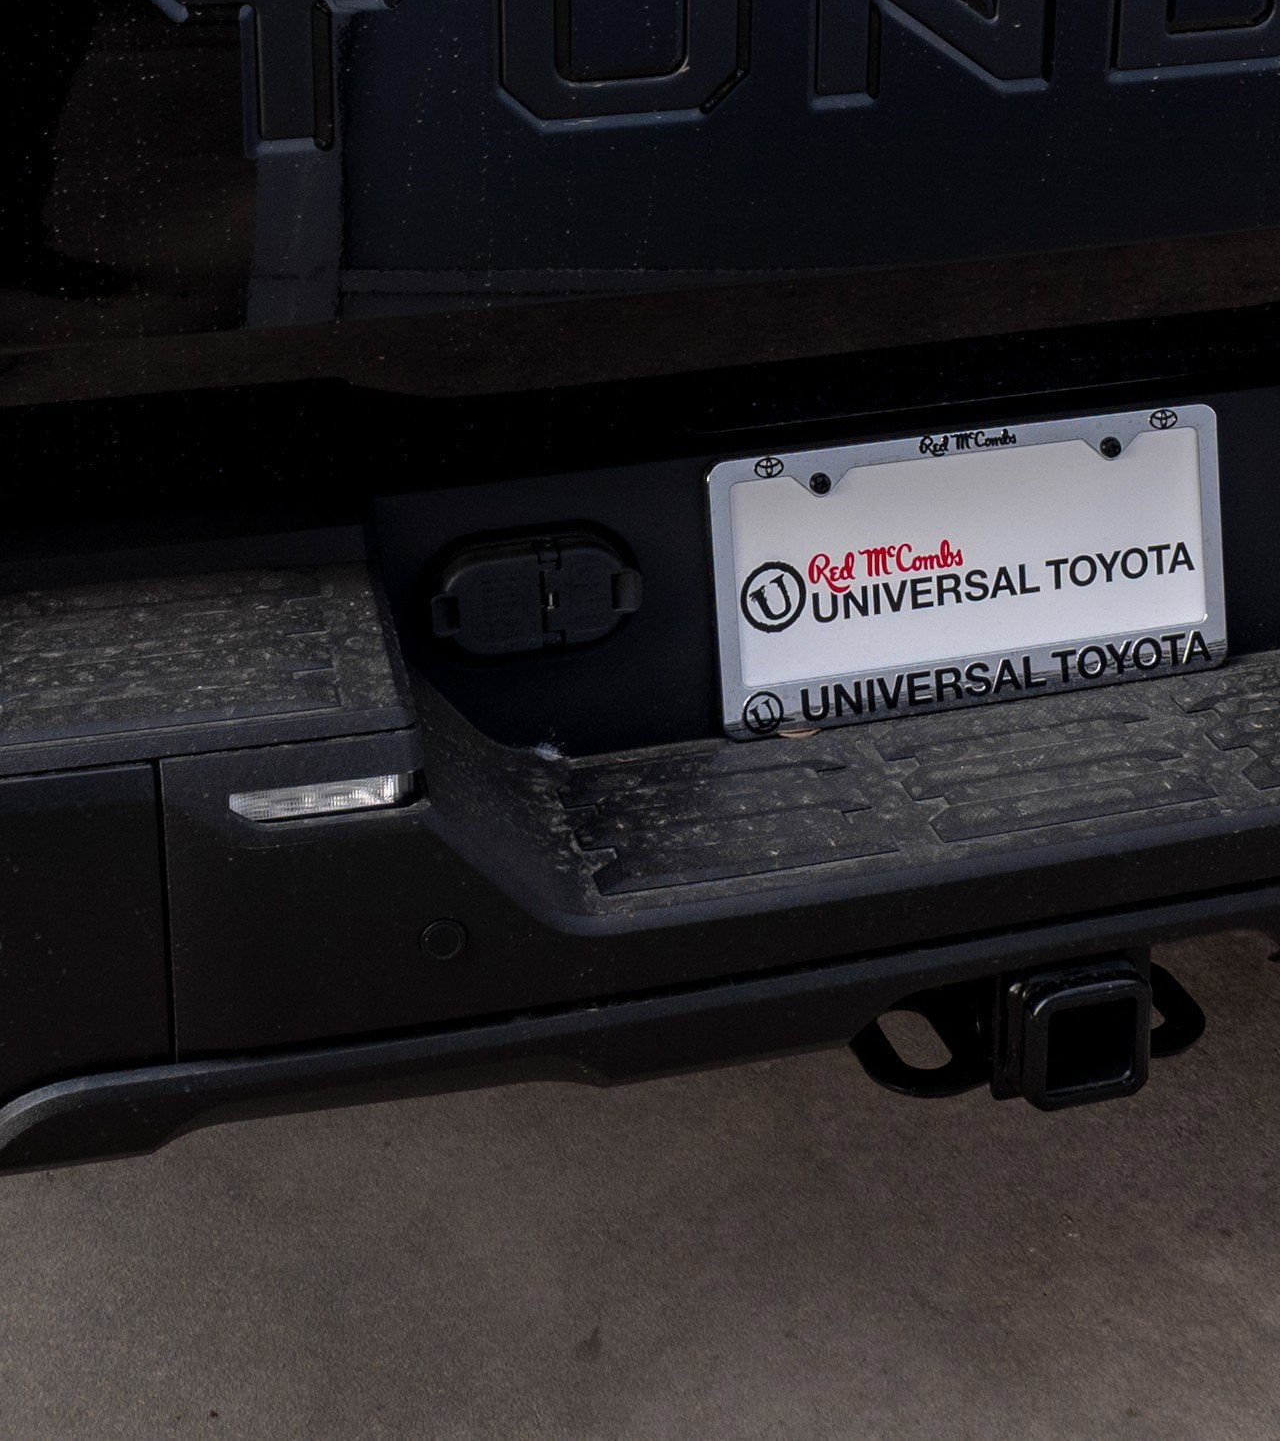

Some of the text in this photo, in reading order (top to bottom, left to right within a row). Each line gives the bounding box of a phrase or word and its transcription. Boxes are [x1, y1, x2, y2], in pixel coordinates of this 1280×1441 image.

[919, 428, 1017, 457] Red McCombs
[808, 539, 963, 593] Red McCombs
[812, 542, 1195, 623] UNIVERSAL TOYOTA
[800, 632, 1211, 722] UNIVERSAL TOYOTA
